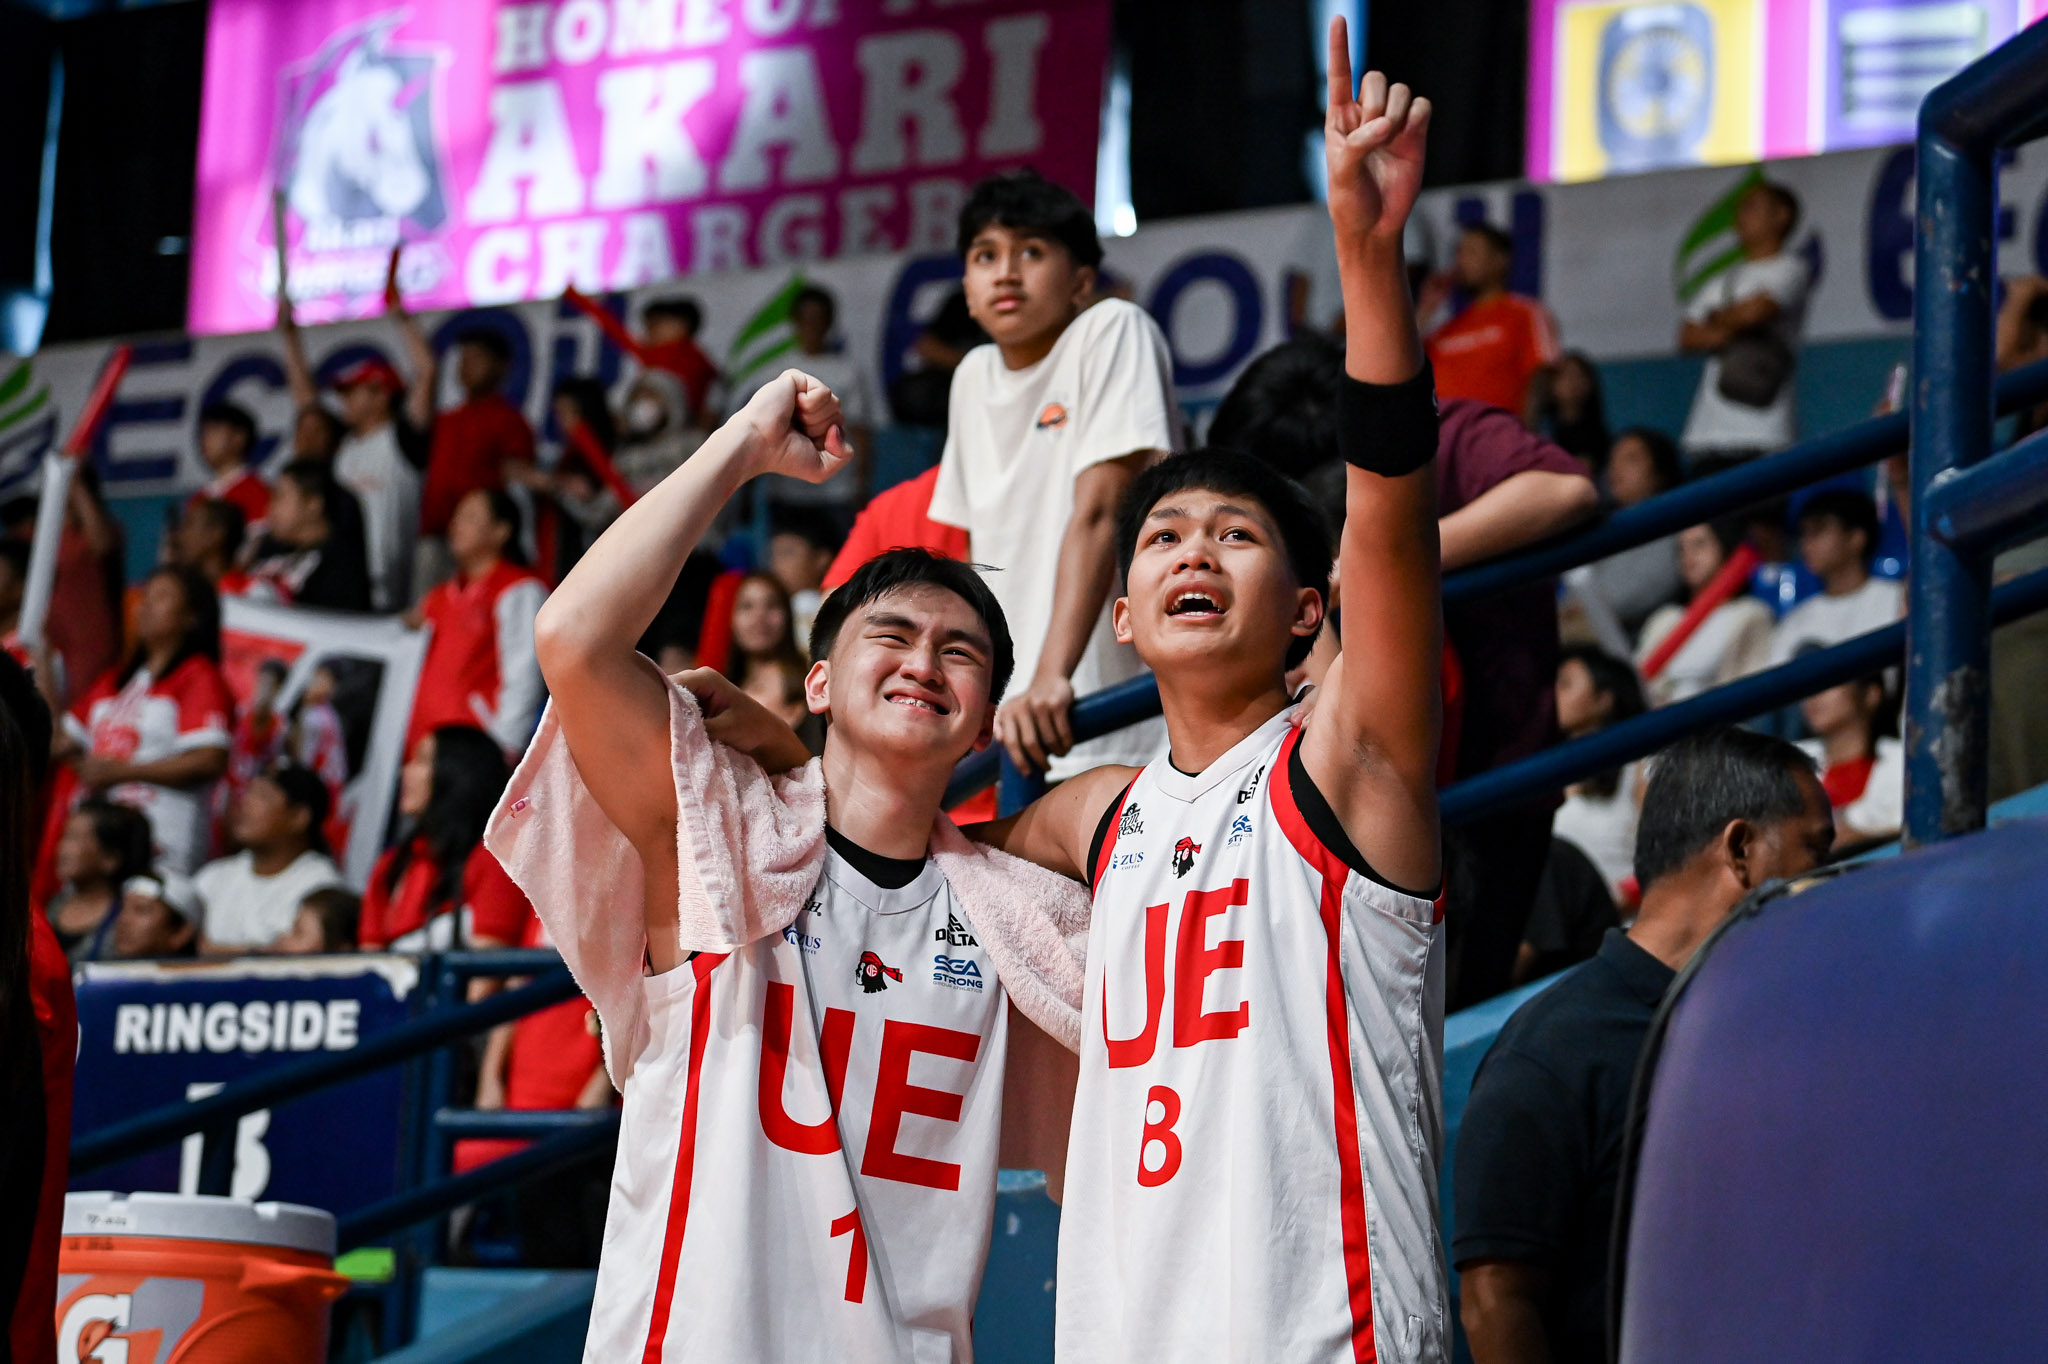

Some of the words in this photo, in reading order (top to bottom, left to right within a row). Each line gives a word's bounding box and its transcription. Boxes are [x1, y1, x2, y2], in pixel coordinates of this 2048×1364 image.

[463, 12, 1048, 224] AKARI
[1120, 852, 1144, 866] ZUS
[935, 928, 979, 948] DELTA
[1102, 878, 1250, 1069] UE
[933, 972, 984, 989] STRONG
[113, 999, 361, 1053] RINGSIDE
[758, 980, 981, 1192] UE
[829, 1206, 868, 1305] 1
[56, 1293, 133, 1364] G
